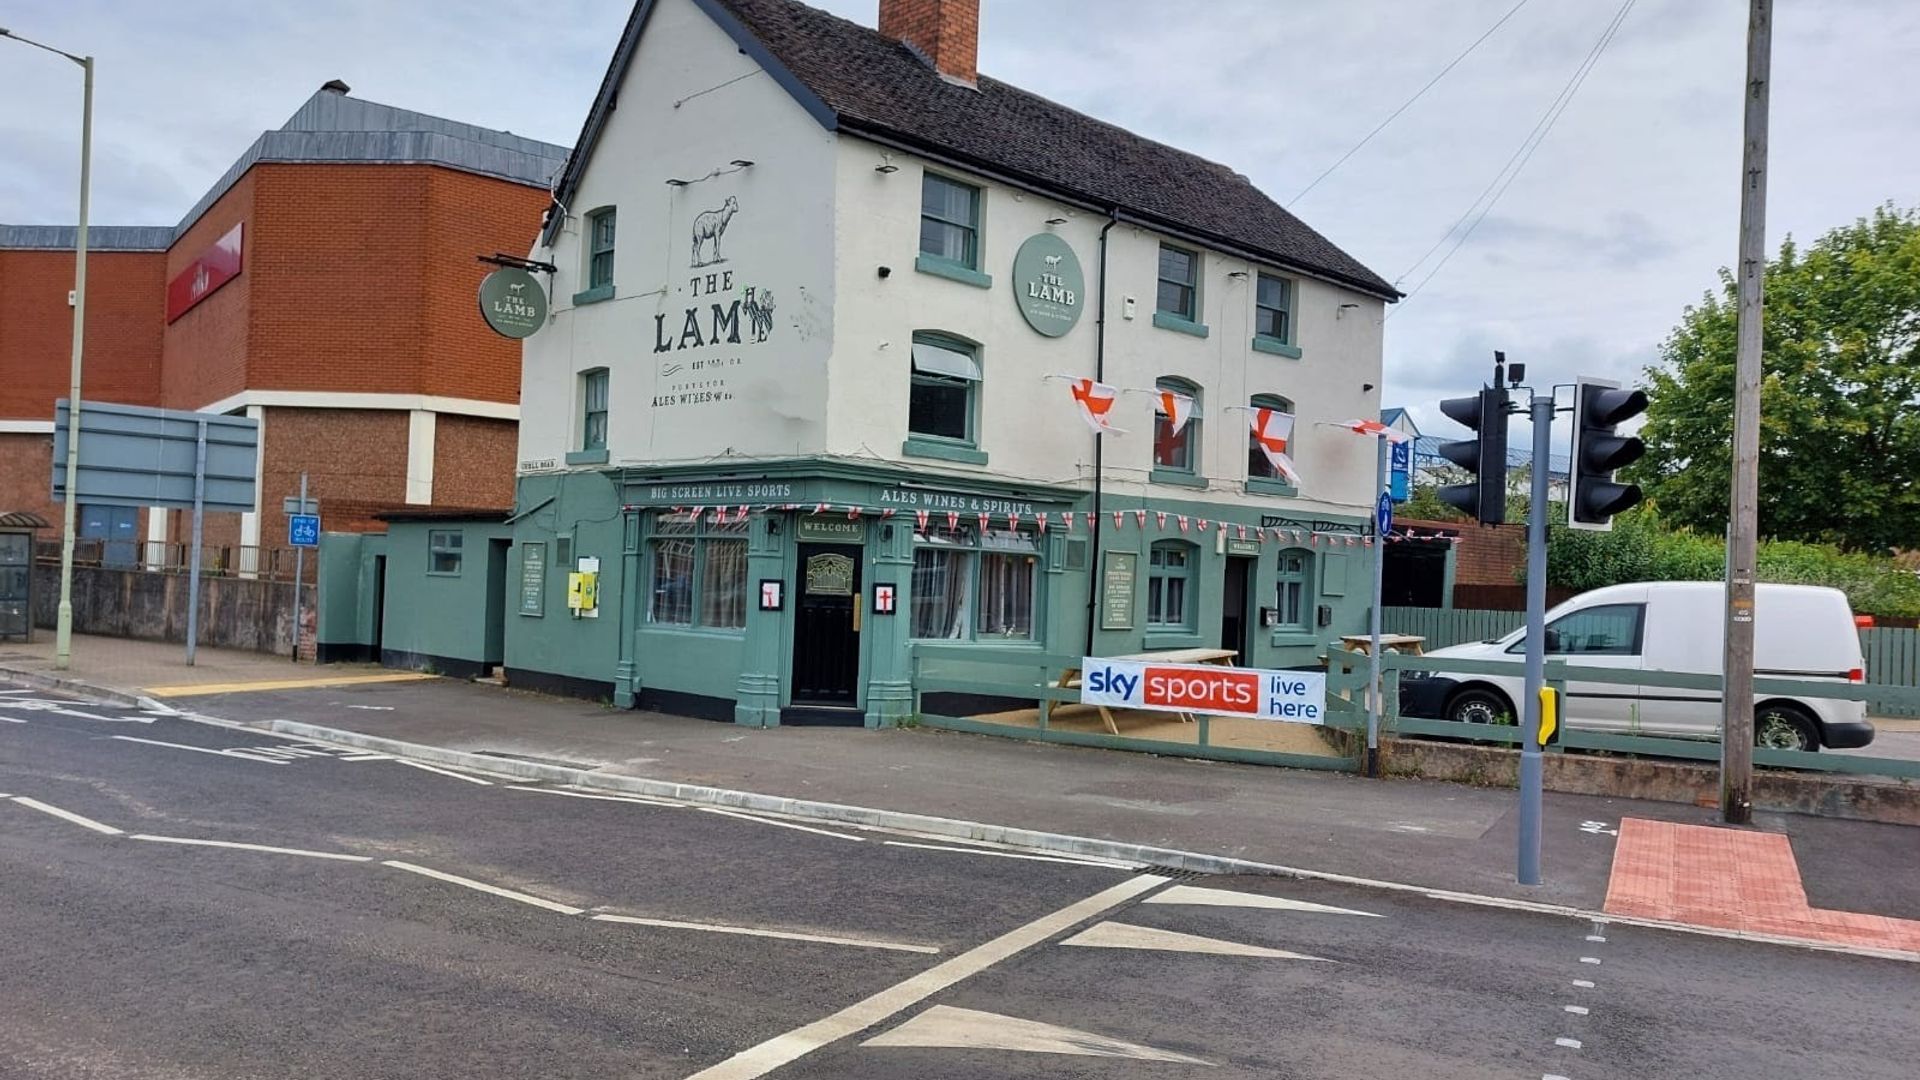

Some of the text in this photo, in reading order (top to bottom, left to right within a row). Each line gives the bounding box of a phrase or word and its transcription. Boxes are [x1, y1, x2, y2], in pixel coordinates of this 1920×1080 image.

[690, 270, 733, 297] THE
[1043, 273, 1064, 286] THE
[505, 295, 525, 305] THE
[1028, 281, 1075, 305] LAMB
[494, 301, 536, 318] LAMB
[651, 395, 676, 407] ALES
[651, 484, 791, 499] BIG SCREEN LIVE SPORTS
[880, 489, 1033, 515] ALES WINES & SPIRITS
[804, 522, 858, 533] WELCOME
[1089, 666, 1306, 705] sky sports live
[1270, 699, 1318, 718] here
